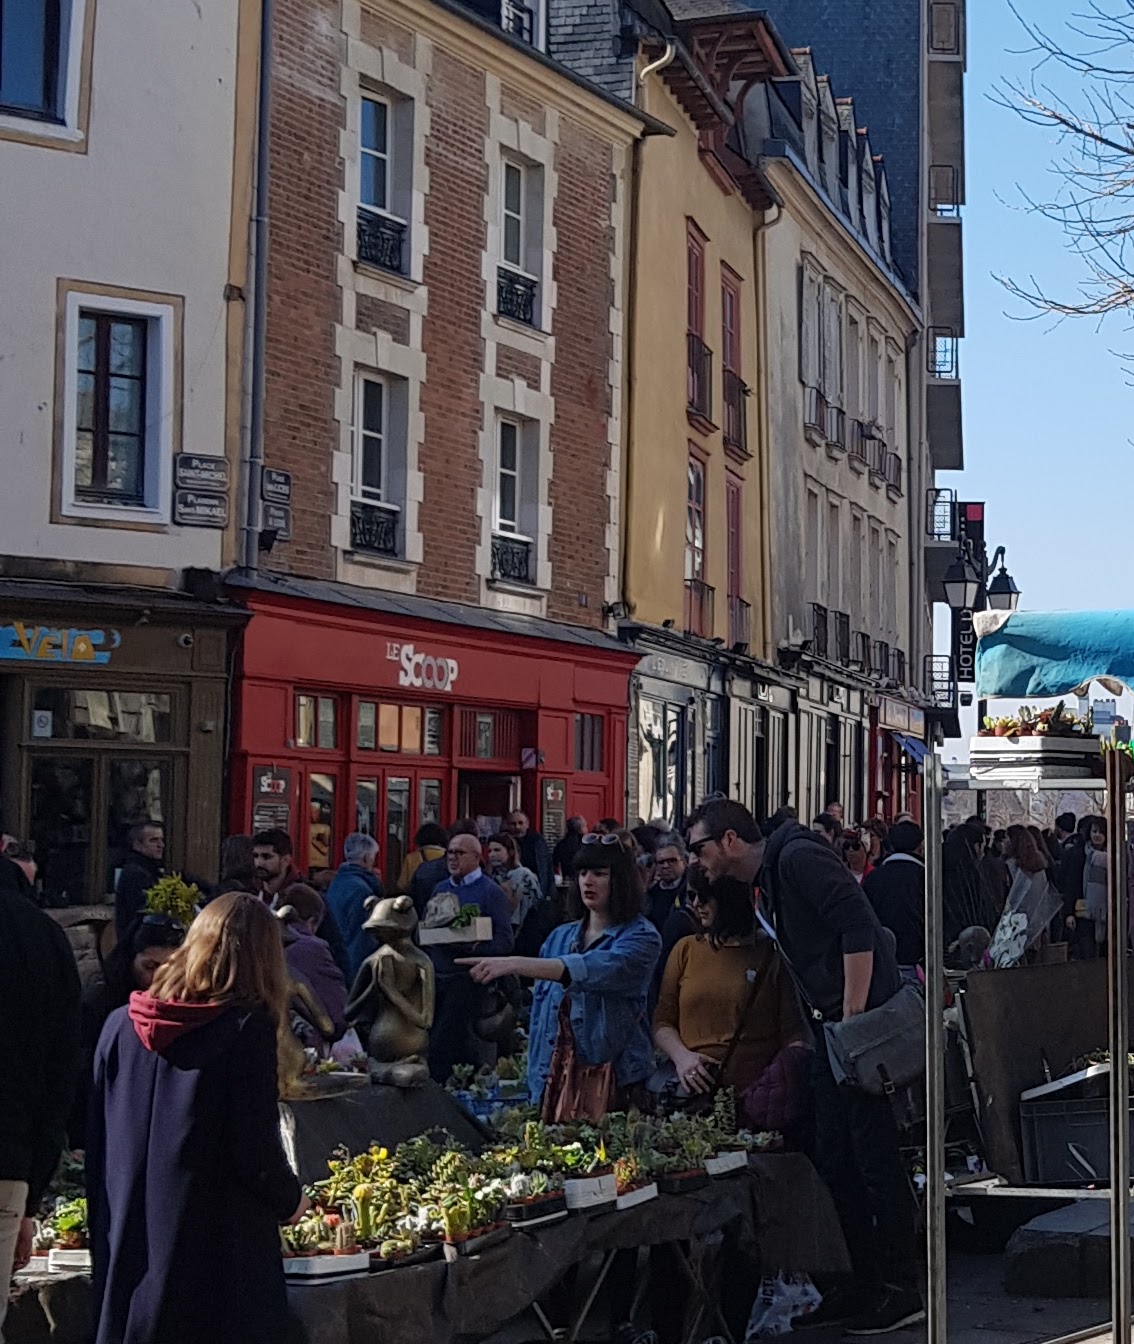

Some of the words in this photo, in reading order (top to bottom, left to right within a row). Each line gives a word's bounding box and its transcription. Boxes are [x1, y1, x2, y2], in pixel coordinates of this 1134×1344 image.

[386, 643, 400, 661] LE
[399, 644, 459, 692] SCOOP
[959, 624, 974, 679] HOTEL
